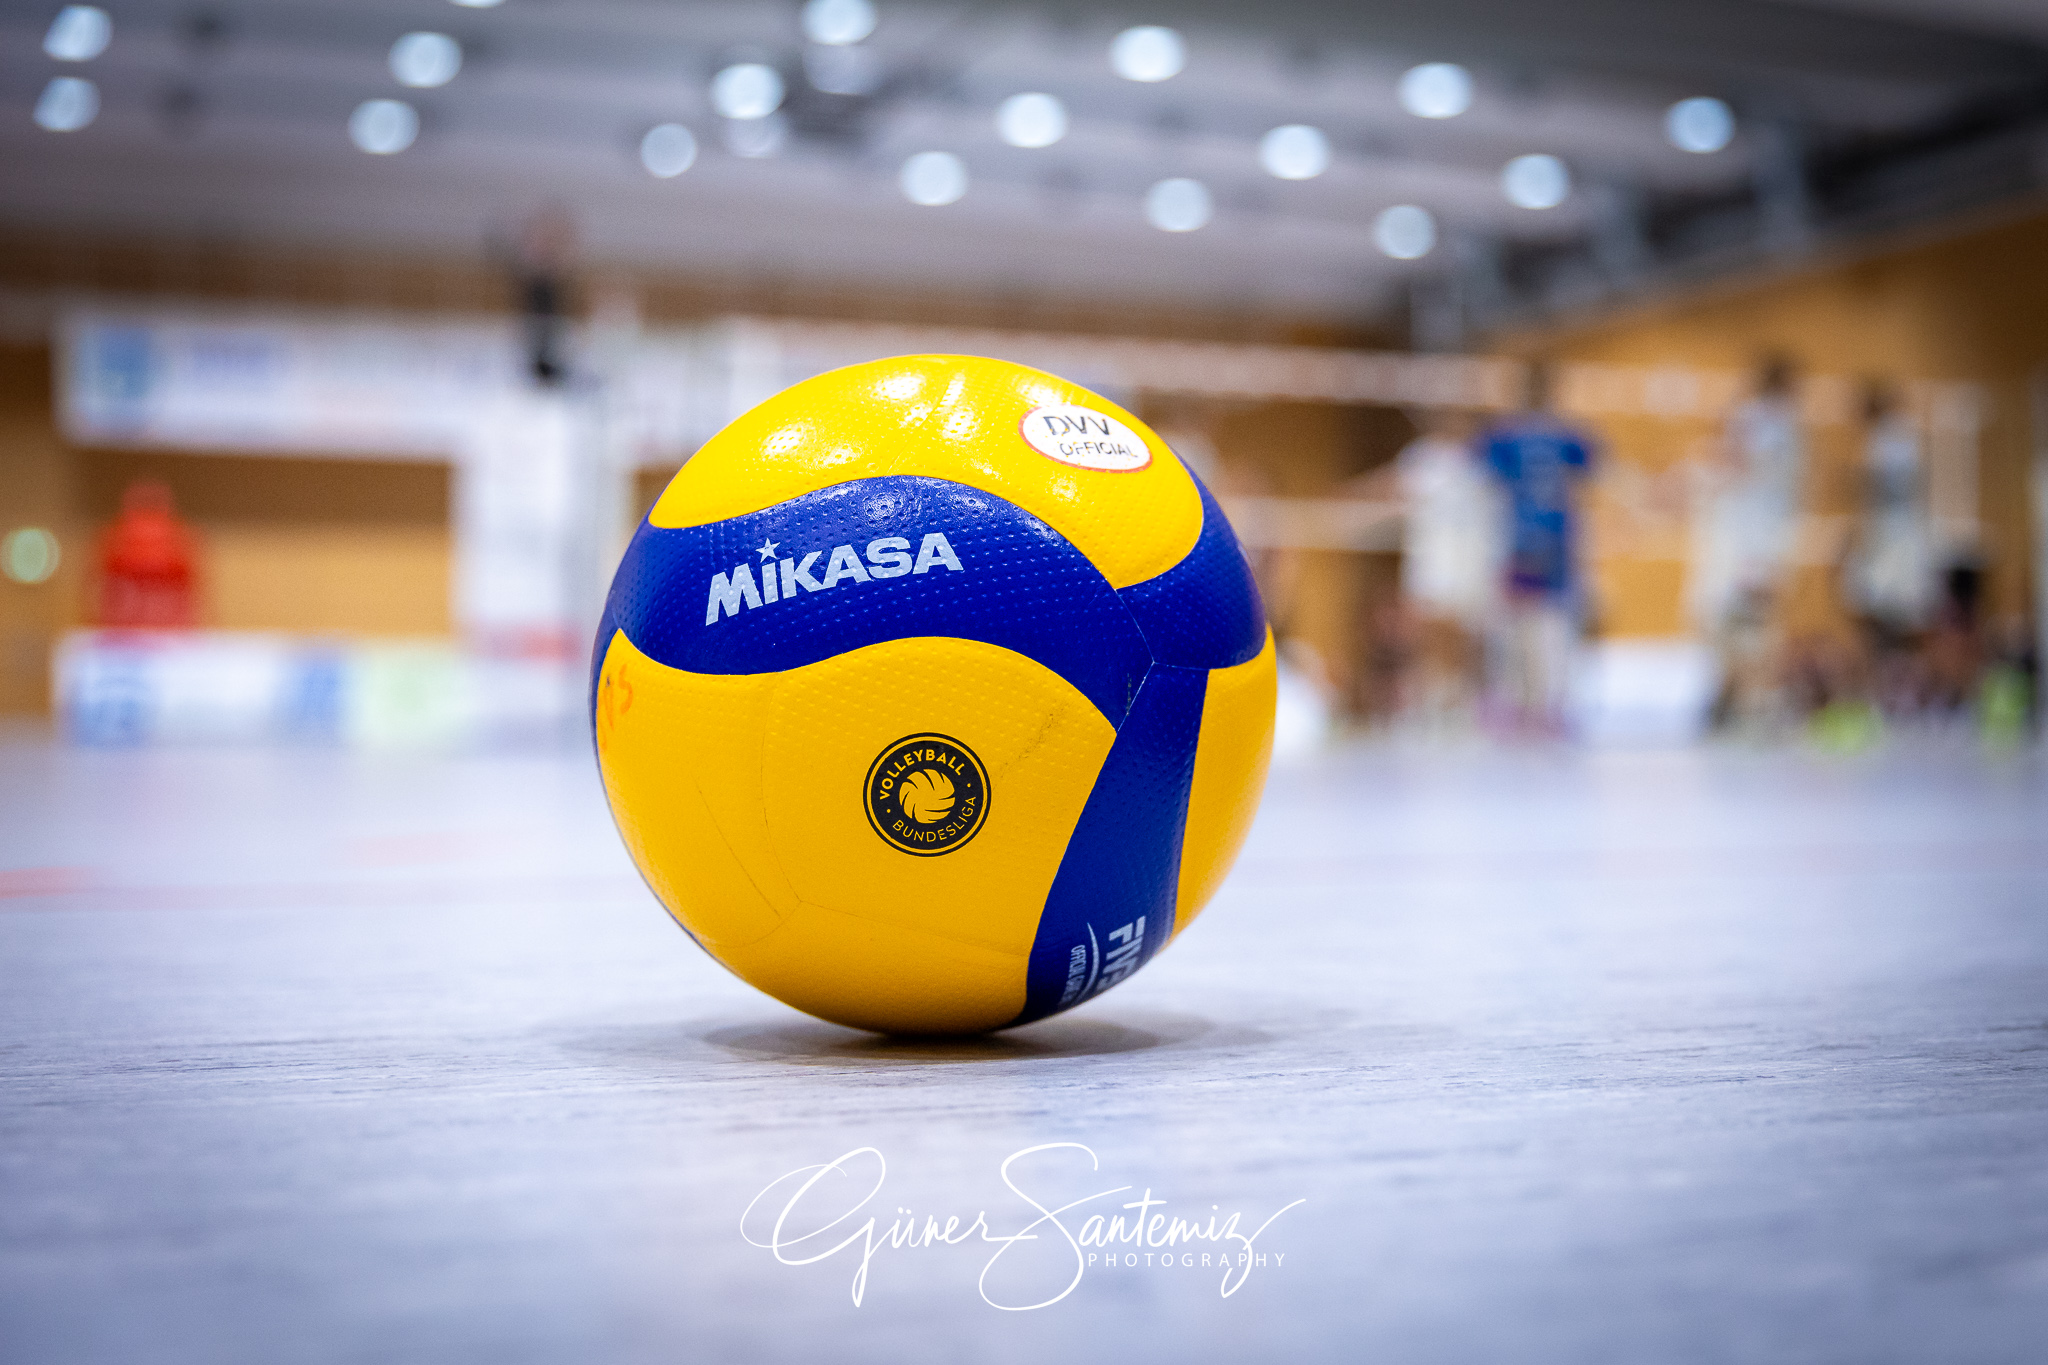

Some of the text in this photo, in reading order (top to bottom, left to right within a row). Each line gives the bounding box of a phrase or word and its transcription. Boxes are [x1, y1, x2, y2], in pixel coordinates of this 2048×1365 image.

[1042, 415, 1110, 436] DVV
[1059, 441, 1139, 458] OFFICIAL
[879, 749, 965, 800] VOLLEYBALL
[892, 796, 976, 843] BUNDESLIGA
